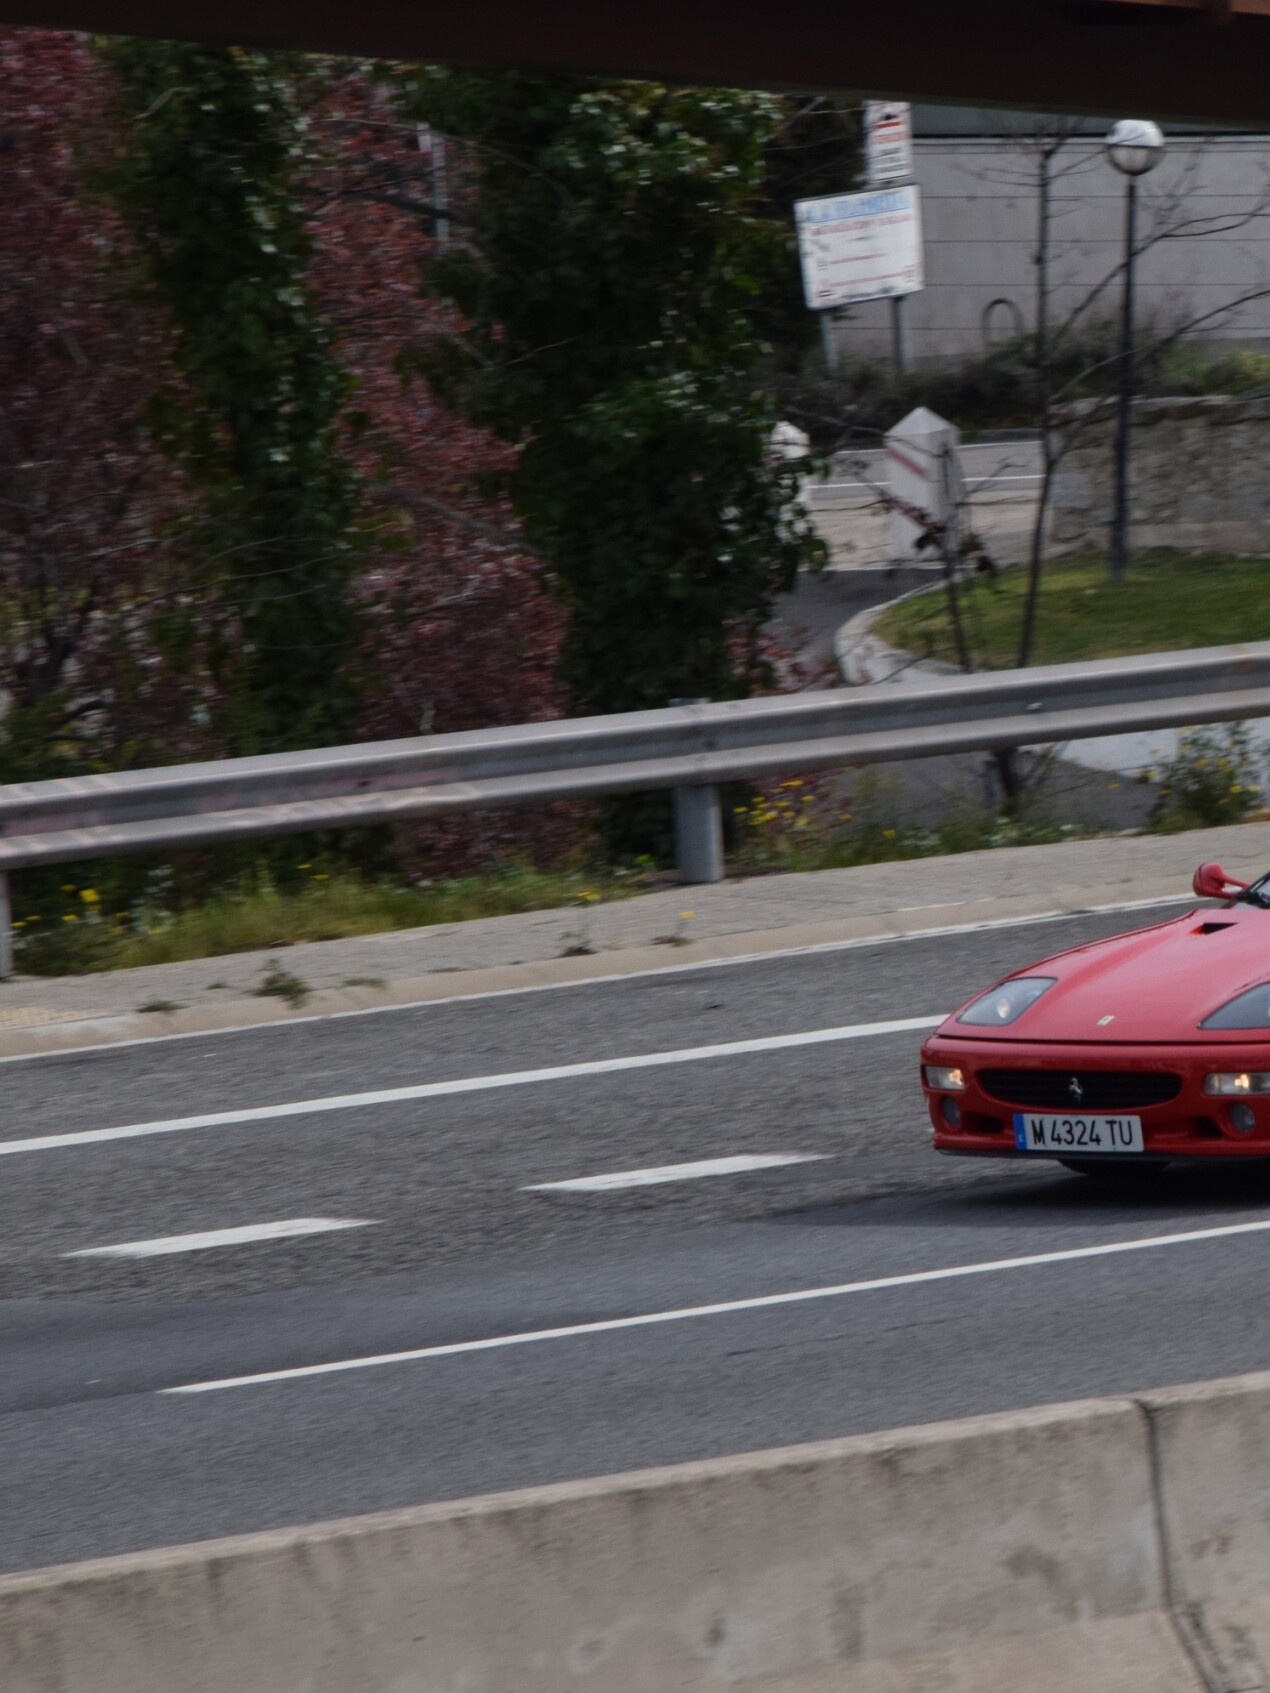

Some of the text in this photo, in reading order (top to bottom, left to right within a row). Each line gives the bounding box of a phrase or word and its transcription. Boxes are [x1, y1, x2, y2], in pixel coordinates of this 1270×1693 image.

[1031, 1119, 1133, 1146] M 4324 TU
